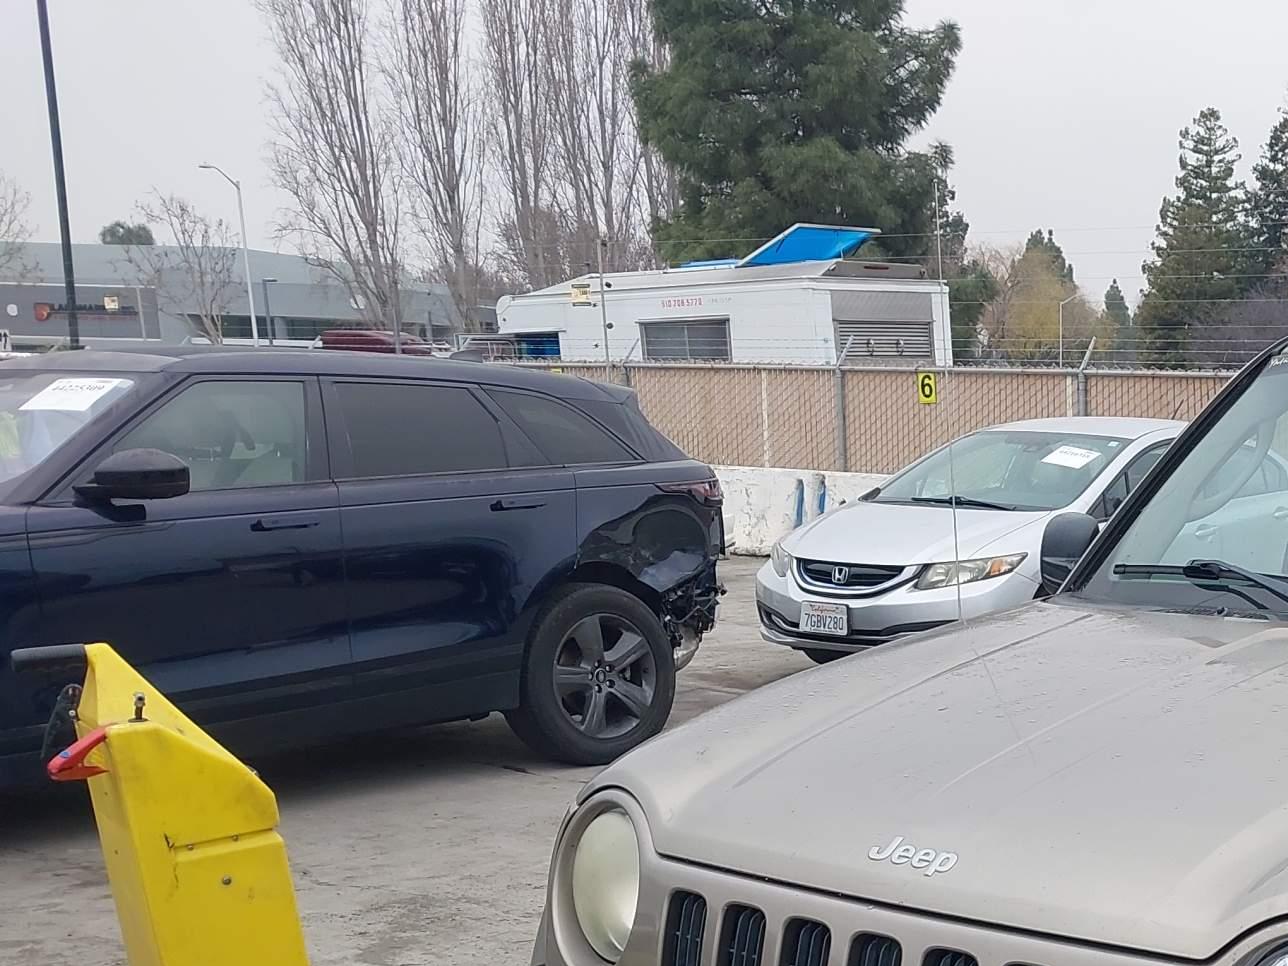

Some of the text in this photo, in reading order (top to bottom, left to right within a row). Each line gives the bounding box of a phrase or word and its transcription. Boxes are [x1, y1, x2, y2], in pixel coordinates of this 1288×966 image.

[921, 374, 933, 398] 6
[804, 612, 844, 630] 7GBV280
[868, 836, 959, 877] Jeep
